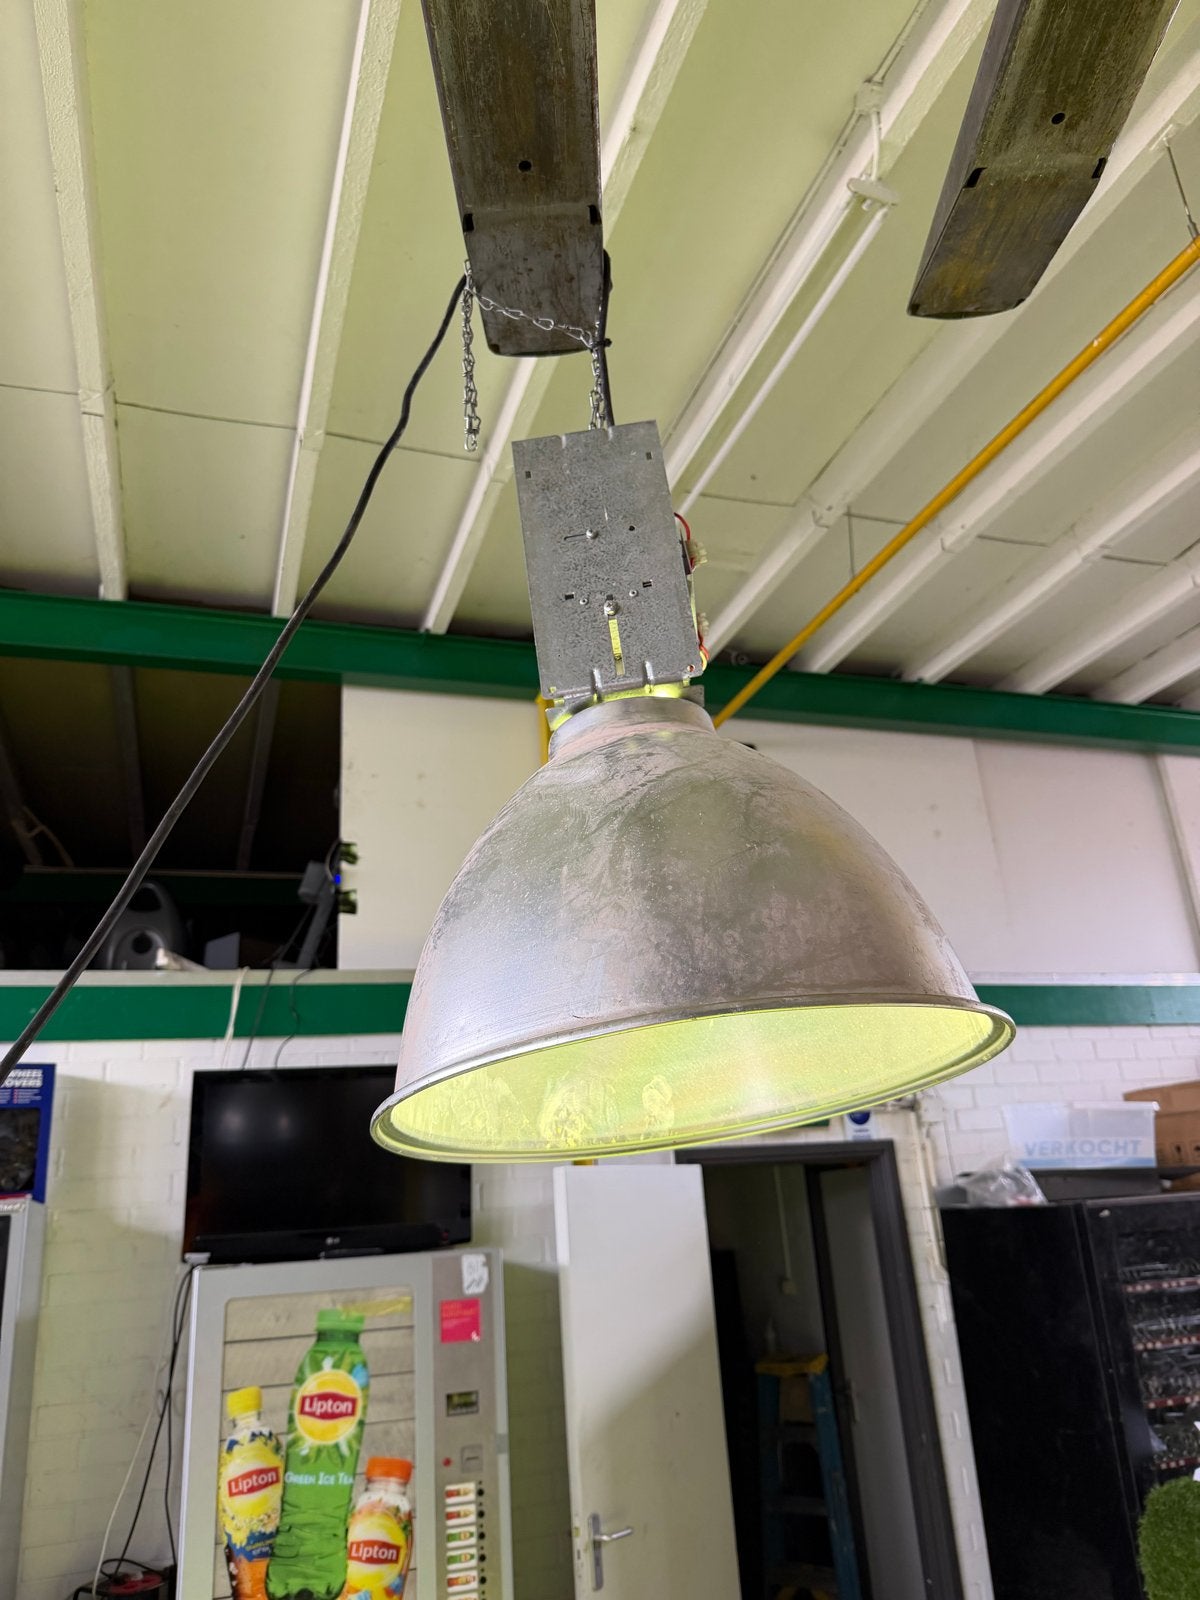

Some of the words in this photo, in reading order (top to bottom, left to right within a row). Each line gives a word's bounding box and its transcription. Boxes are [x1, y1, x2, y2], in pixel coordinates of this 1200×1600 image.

[1024, 1139, 1142, 1157] VERKOCHT
[303, 1397, 353, 1416] Lipton
[230, 1471, 277, 1493] Lipton
[350, 1543, 398, 1561] Lipton
